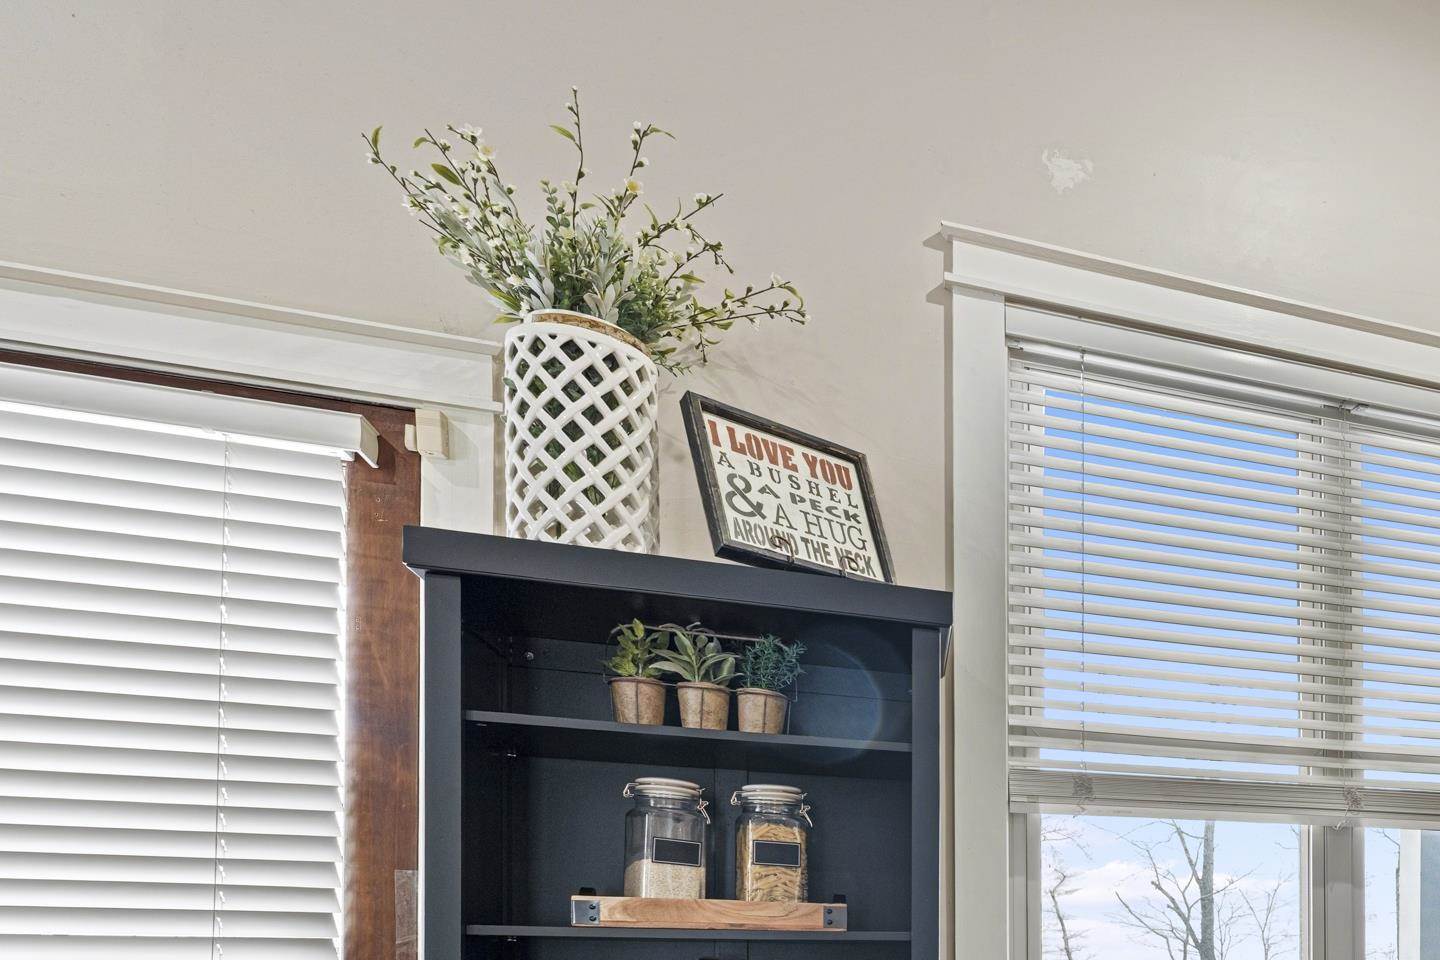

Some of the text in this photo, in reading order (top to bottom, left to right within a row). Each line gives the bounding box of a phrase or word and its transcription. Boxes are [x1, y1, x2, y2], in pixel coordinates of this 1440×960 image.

[707, 420, 853, 491] I LOVE YOU
[717, 451, 858, 510] A BUSHEL
[725, 472, 862, 525] & A PECK
[732, 516, 799, 557] AROUND
[800, 536, 834, 566] THE
[773, 503, 868, 552] A HUG
